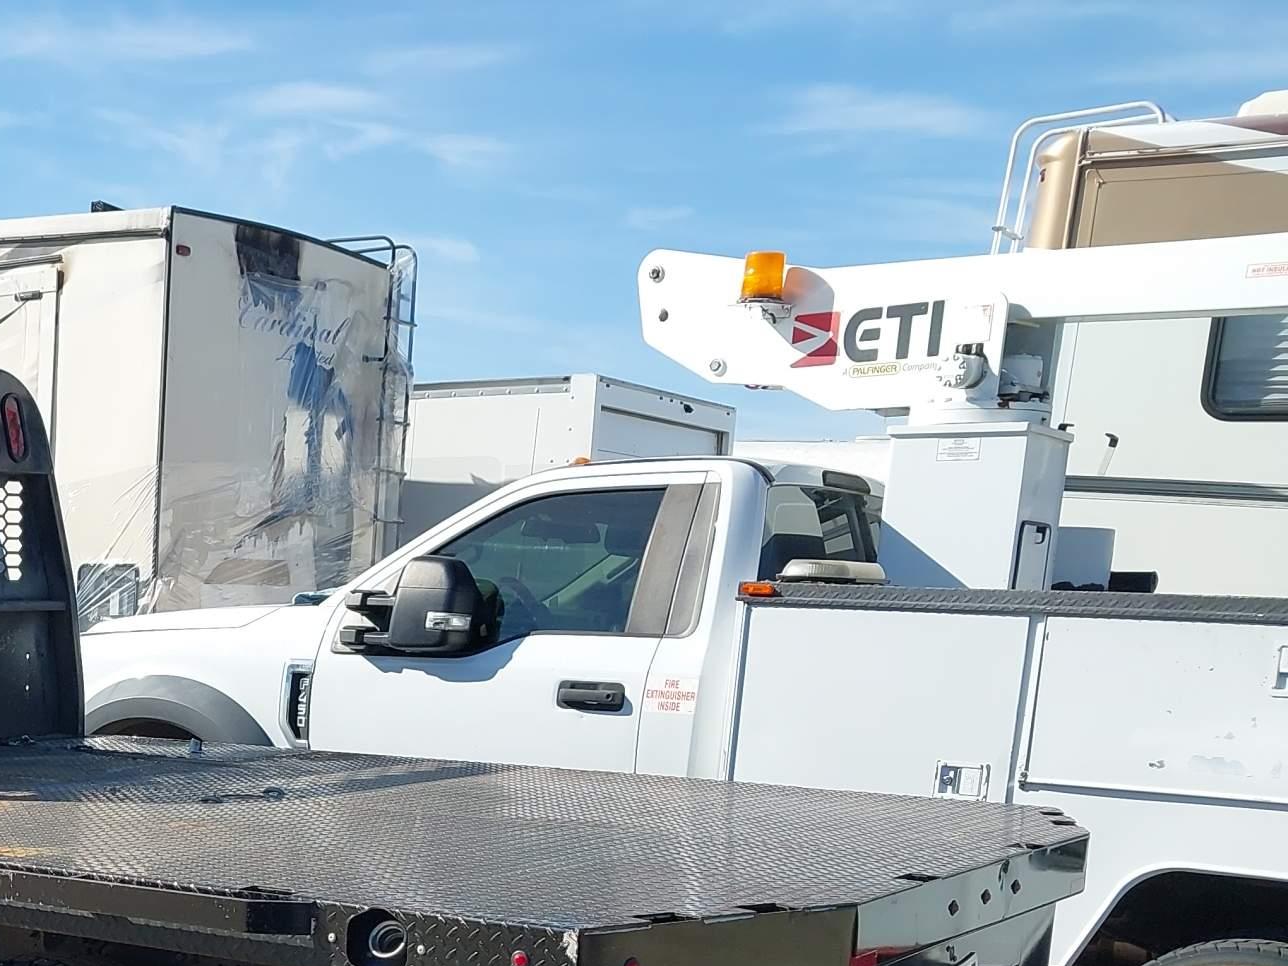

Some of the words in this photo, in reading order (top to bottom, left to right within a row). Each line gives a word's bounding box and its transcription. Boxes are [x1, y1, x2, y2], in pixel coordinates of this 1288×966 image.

[843, 300, 945, 363] ETI
[852, 364, 898, 376] PALFINGER
[664, 679, 681, 689] FIRE
[646, 689, 696, 701] EXTINGUISHER
[657, 701, 681, 712] INSIDE
